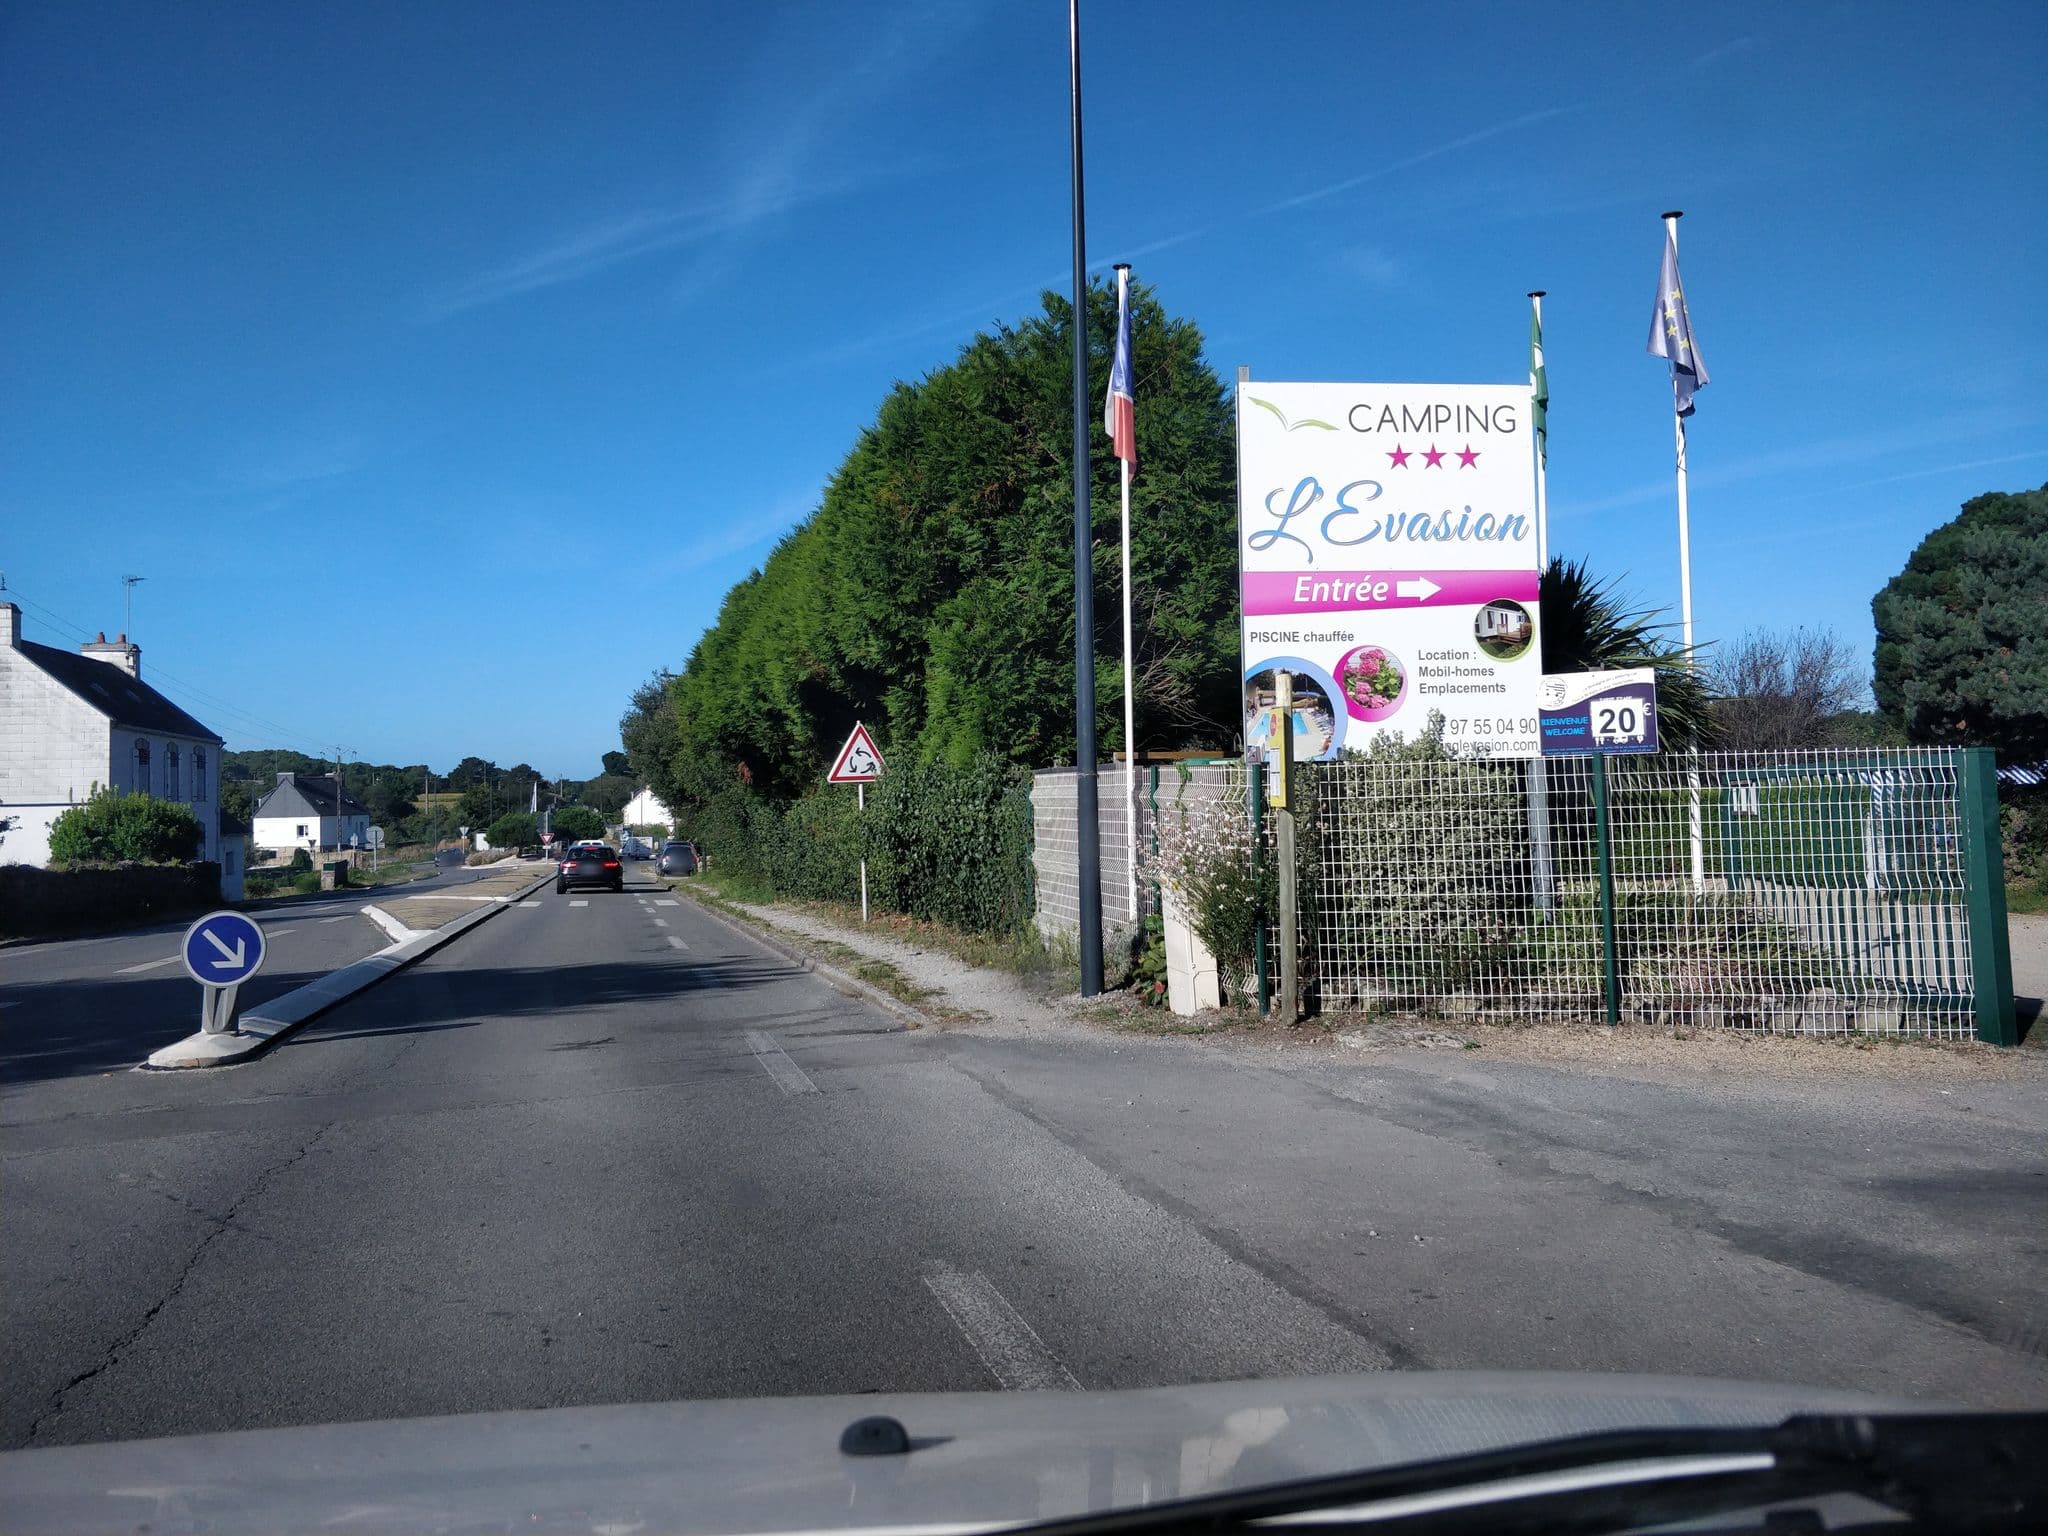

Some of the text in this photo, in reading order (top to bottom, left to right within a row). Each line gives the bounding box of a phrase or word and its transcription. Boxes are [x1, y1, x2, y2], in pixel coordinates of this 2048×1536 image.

[1348, 403, 1517, 434] CAMPING
[1247, 476, 1530, 565] L'Evasion
[1293, 575, 1389, 603] Entrée
[1250, 630, 1355, 643] PISCINE chauffée
[1418, 648, 1470, 661] Location
[1418, 665, 1495, 678] Mobil-homes
[1419, 682, 1507, 696] Emplacements
[1450, 719, 1468, 735] 97
[1474, 719, 1492, 735] 55
[1496, 718, 1514, 734] 04
[1519, 718, 1537, 734] 90
[1599, 707, 1636, 734] 20
[1545, 726, 1586, 736] WELCOME
